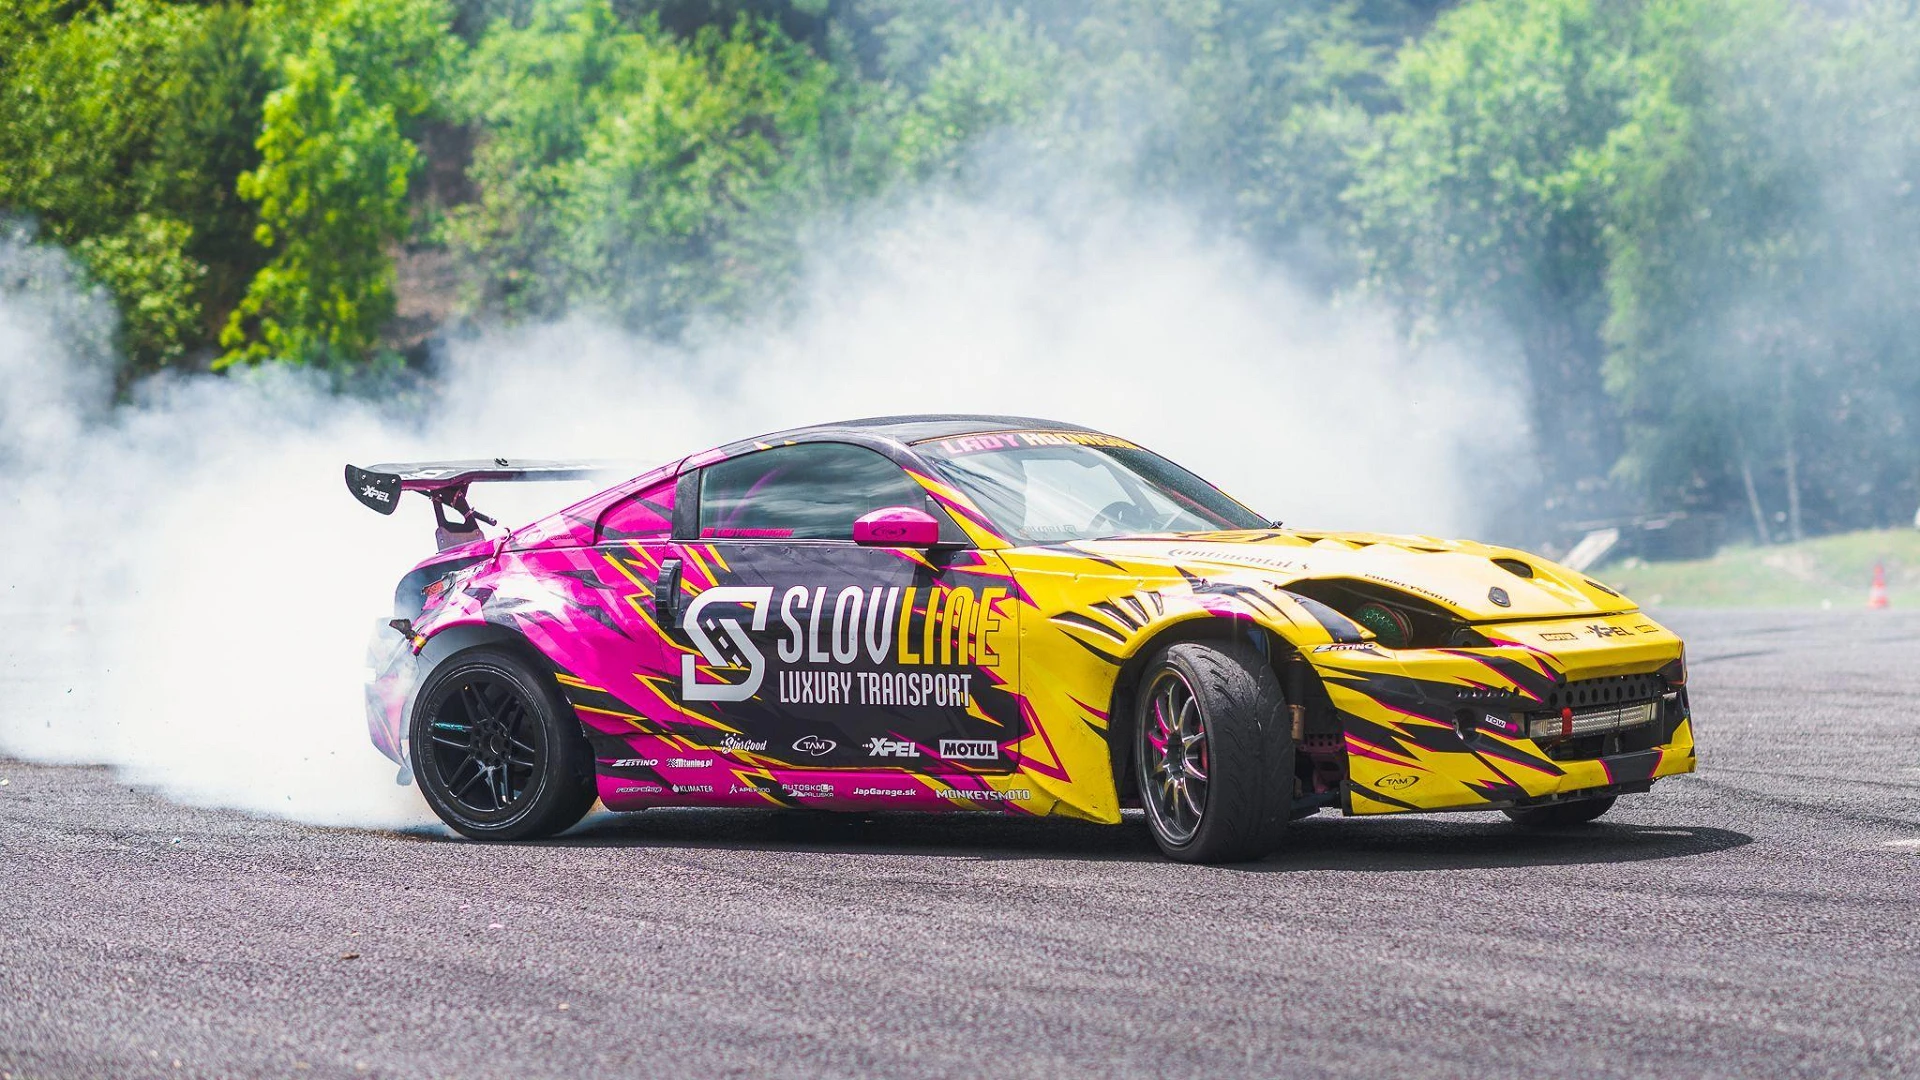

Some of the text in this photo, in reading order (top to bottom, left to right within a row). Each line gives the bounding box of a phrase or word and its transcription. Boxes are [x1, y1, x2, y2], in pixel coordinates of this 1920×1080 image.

[941, 434, 1020, 453] LADY
[363, 485, 390, 502] XPEL
[777, 585, 1008, 666] SLOVLINE
[1313, 643, 1376, 653] ZESTINO
[779, 671, 972, 708] LUXURY TRANSPORT
[1487, 715, 1505, 727] TOW
[803, 741, 826, 750] TAM
[868, 737, 921, 757] XPEL
[942, 742, 996, 757] MOTUL
[612, 758, 659, 767] ZESTINO
[680, 785, 713, 793] KLIMATER
[853, 788, 916, 797] JapGarage.sk
[935, 788, 1031, 801] MONKEYSMOTO
